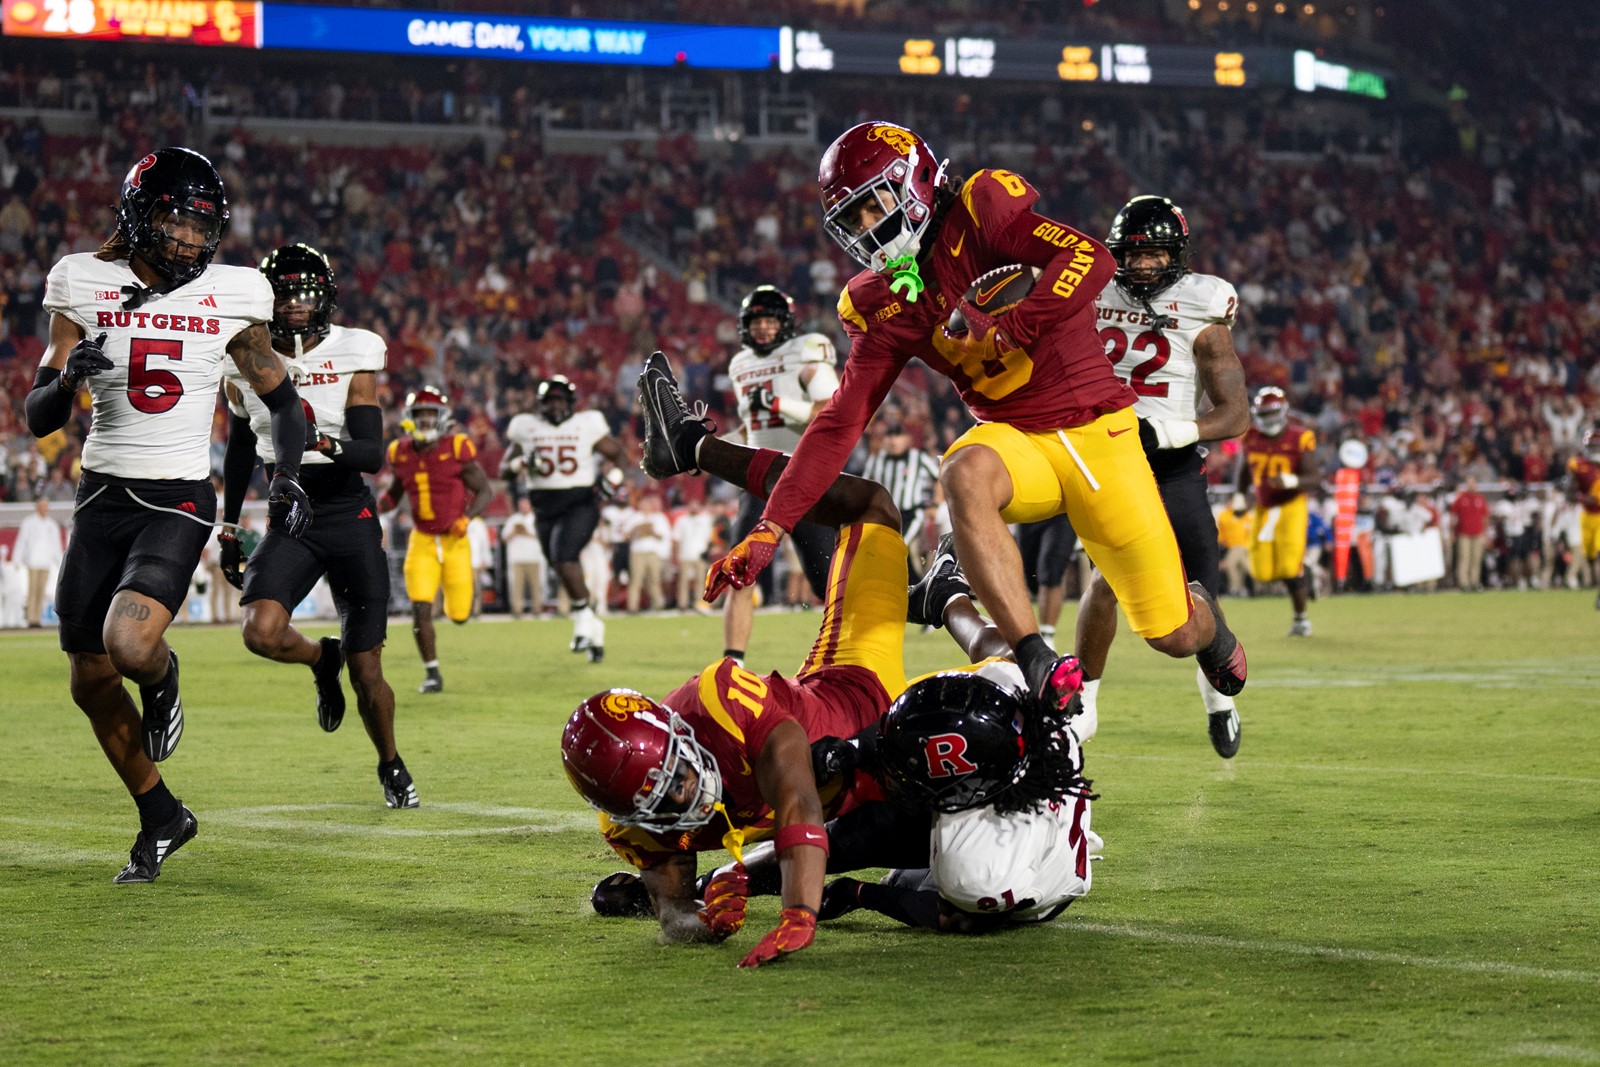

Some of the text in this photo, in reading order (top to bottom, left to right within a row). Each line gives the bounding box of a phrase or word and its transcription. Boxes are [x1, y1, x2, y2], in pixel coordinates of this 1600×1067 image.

[43, 0, 96, 34] 28
[407, 19, 473, 46] GAME
[527, 25, 591, 51] YOUR
[594, 28, 647, 54] WAY
[991, 169, 1027, 198] 6
[193, 200, 213, 210] FTC
[1032, 222, 1079, 248] GOLD
[97, 311, 220, 335] RUTGERS
[1097, 307, 1179, 330] RUTGES
[127, 337, 184, 414] 5
[1100, 327, 1171, 398] 22
[534, 445, 578, 478] 55
[1248, 452, 1292, 489] 70
[414, 472, 436, 520] 1
[727, 665, 768, 720] 10
[919, 732, 979, 779] R
